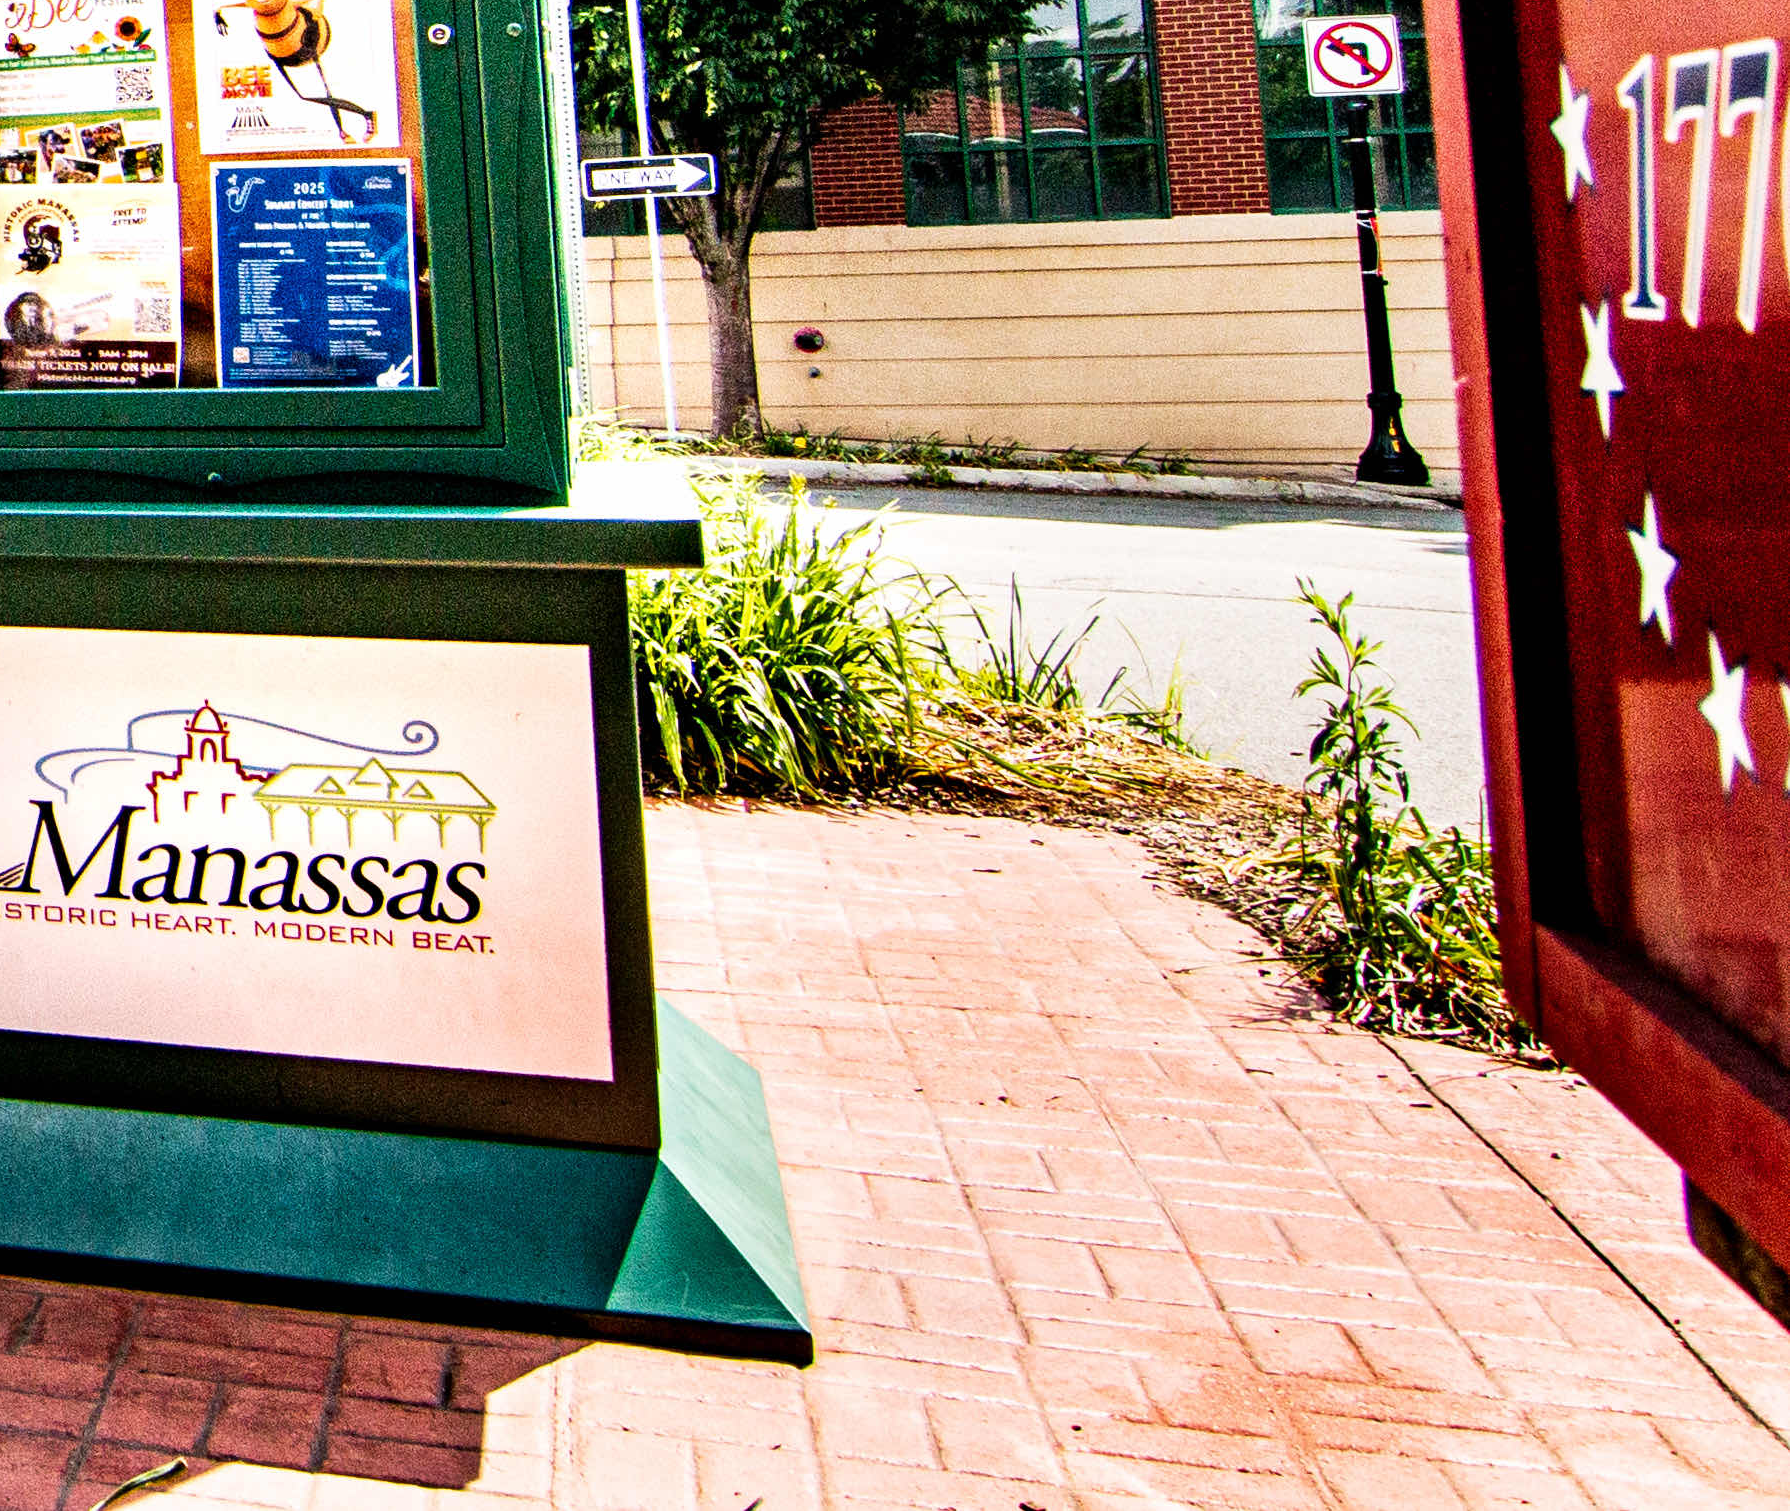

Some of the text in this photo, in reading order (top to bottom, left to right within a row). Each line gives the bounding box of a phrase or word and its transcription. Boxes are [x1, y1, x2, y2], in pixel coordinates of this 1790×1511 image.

[221, 66, 272, 87] BEE
[640, 169, 675, 184] WAY
[1616, 36, 1790, 335] 177
[293, 182, 325, 195] 2025
[39, 360, 89, 372] TICKETS
[90, 361, 119, 372] NOW
[121, 361, 139, 372] ON
[20, 800, 487, 925] Manassas
[131, 910, 237, 938] HEART.
[253, 921, 394, 948] MODERN
[412, 931, 495, 955] BEAT.
